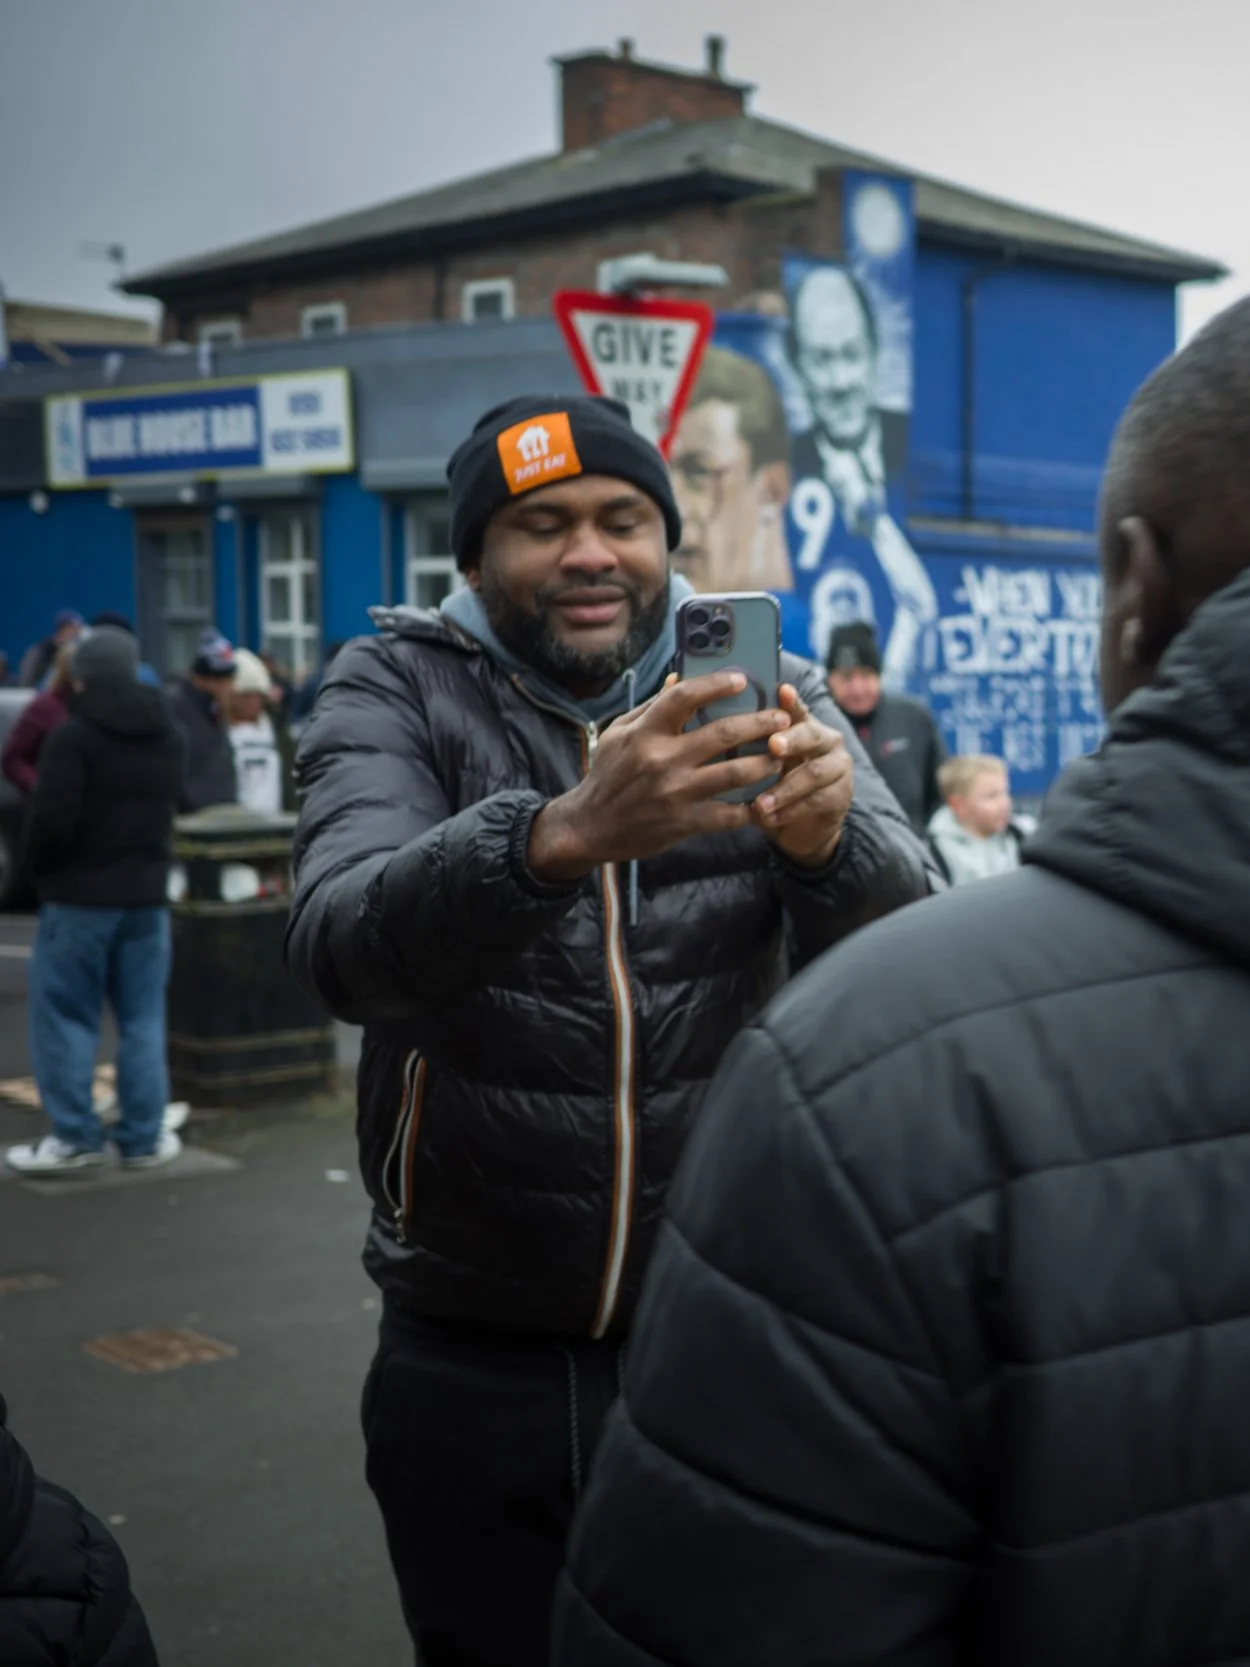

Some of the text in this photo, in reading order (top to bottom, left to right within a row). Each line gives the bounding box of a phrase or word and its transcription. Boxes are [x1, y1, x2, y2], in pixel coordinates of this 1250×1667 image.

[592, 321, 677, 369] GIVE
[613, 378, 663, 403] WAY
[514, 453, 567, 484] JUST EAT
[790, 476, 836, 570] 9
